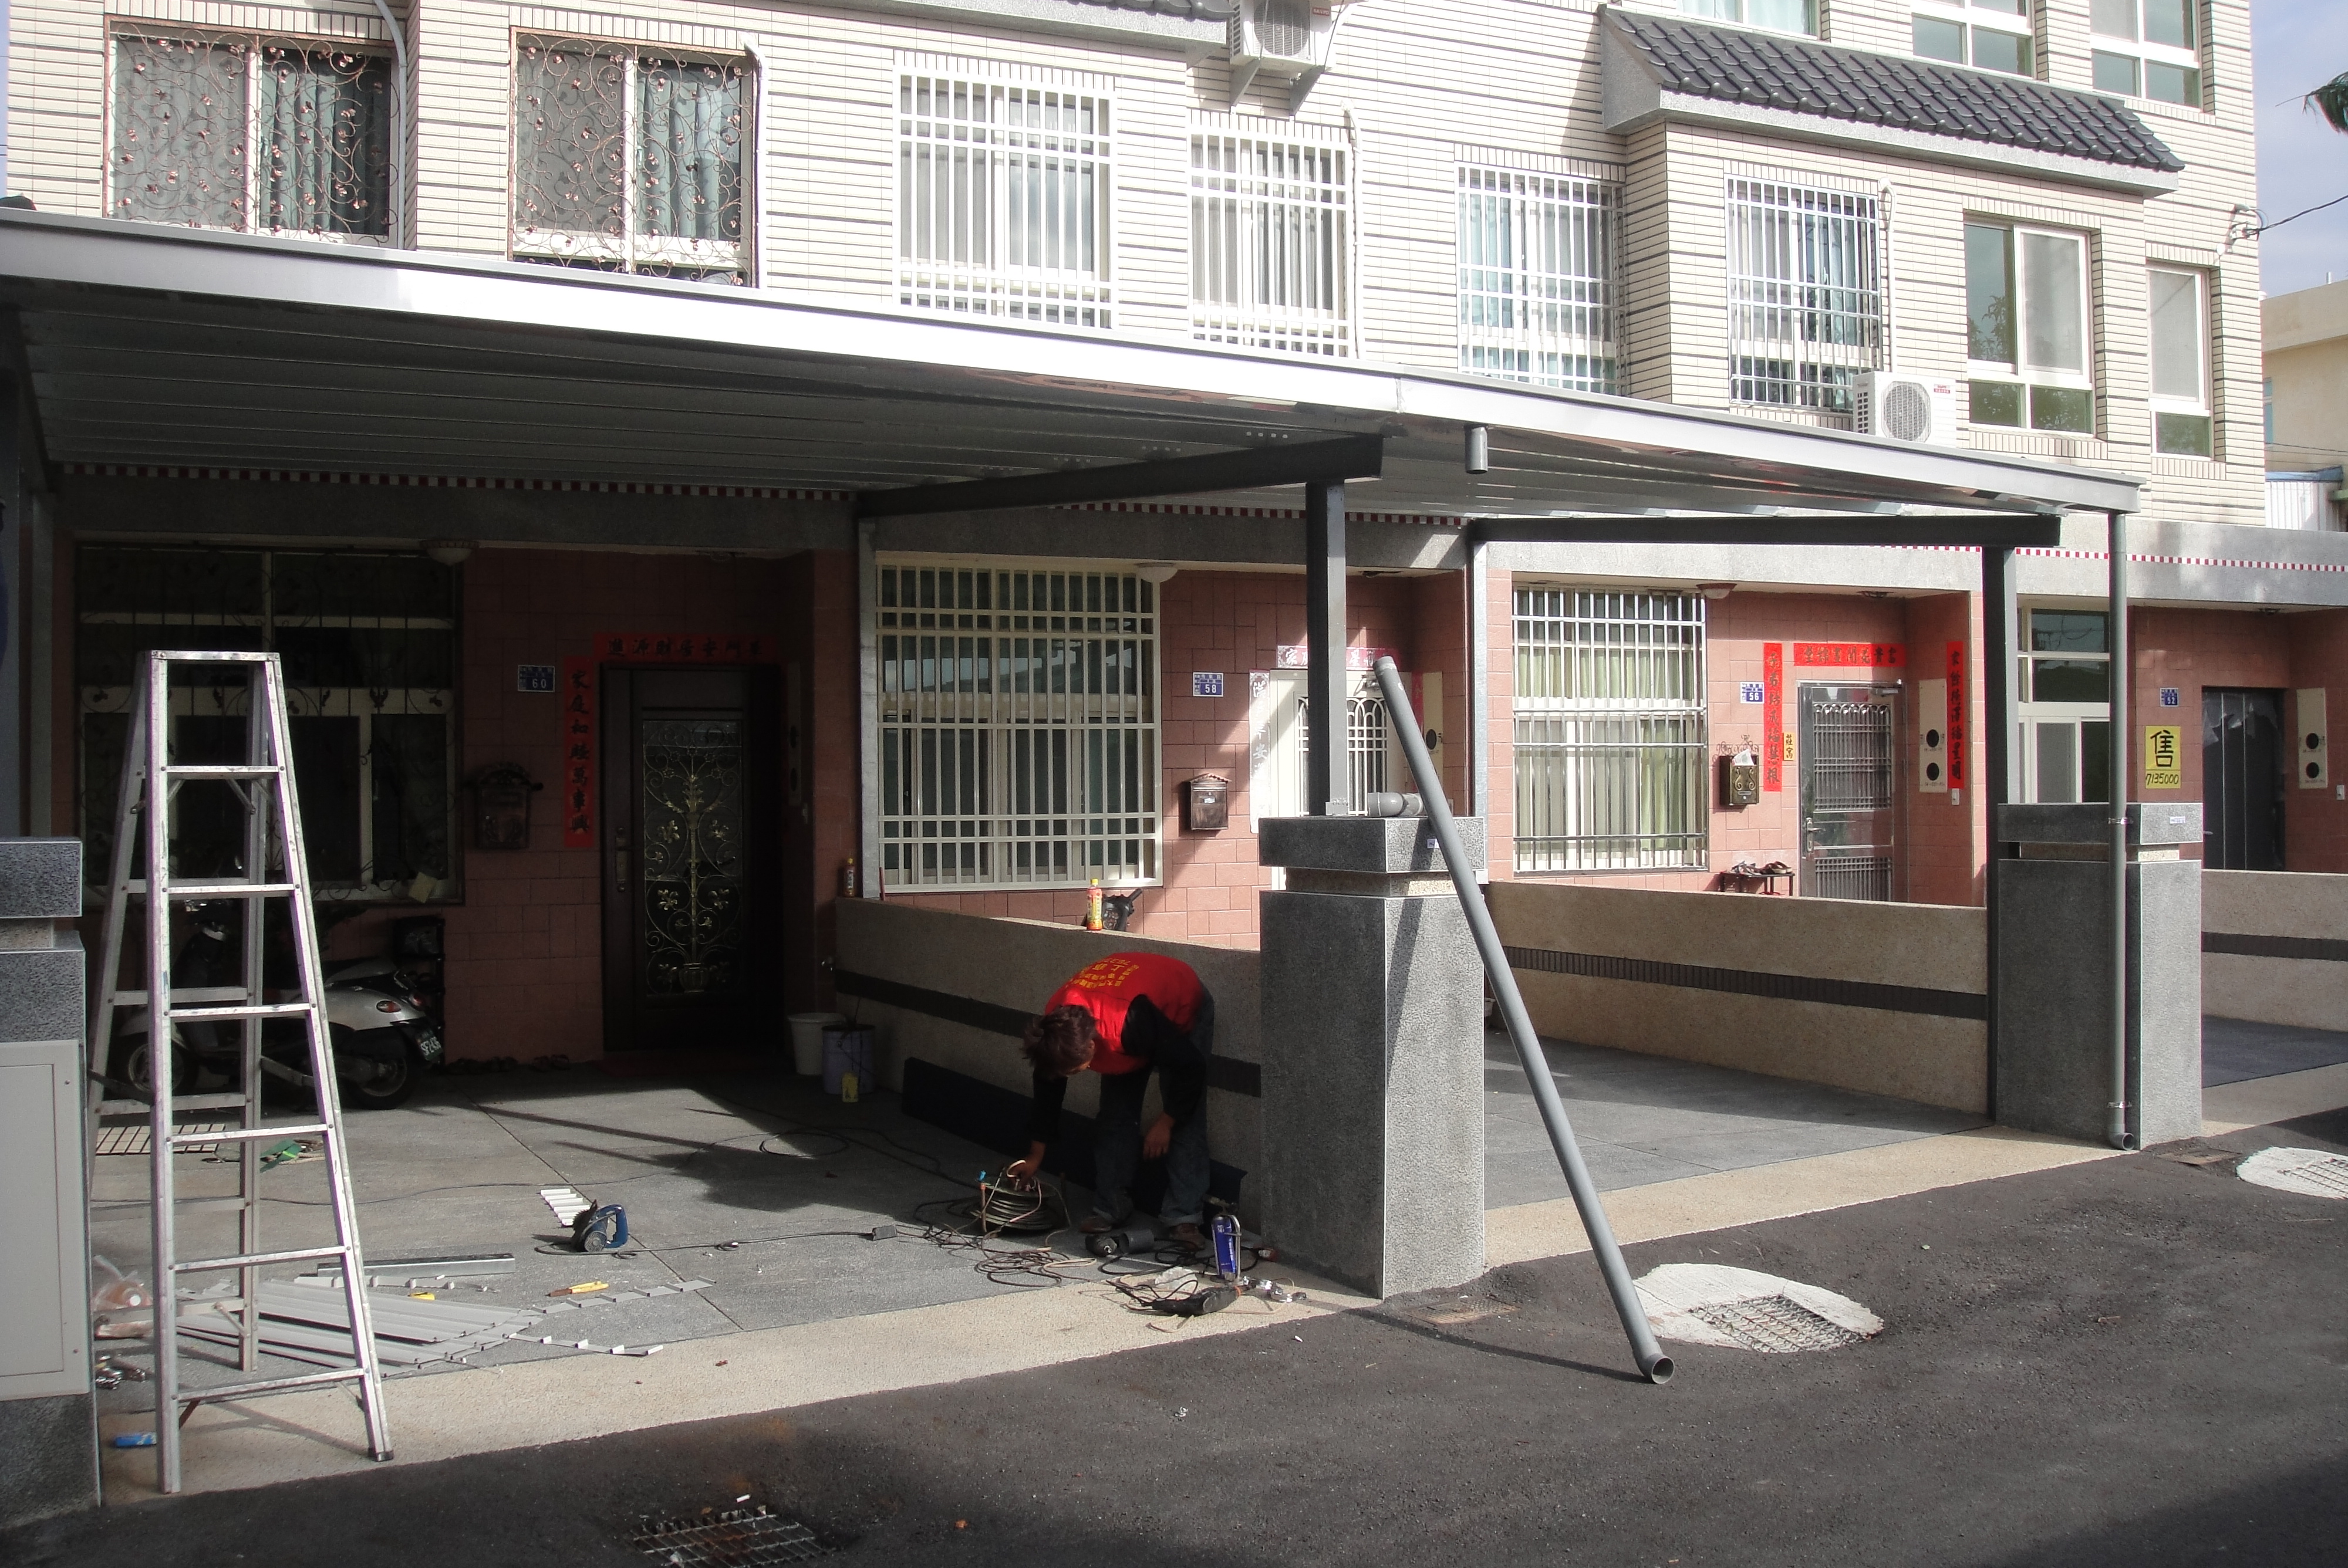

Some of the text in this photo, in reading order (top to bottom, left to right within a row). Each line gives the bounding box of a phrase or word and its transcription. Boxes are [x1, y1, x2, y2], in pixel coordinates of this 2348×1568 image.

[532, 678, 546, 689] 60
[1205, 684, 1217, 694] 58
[1749, 692, 1759, 701] 56
[2150, 729, 2174, 768] 售
[2145, 773, 2179, 785] 7135000
